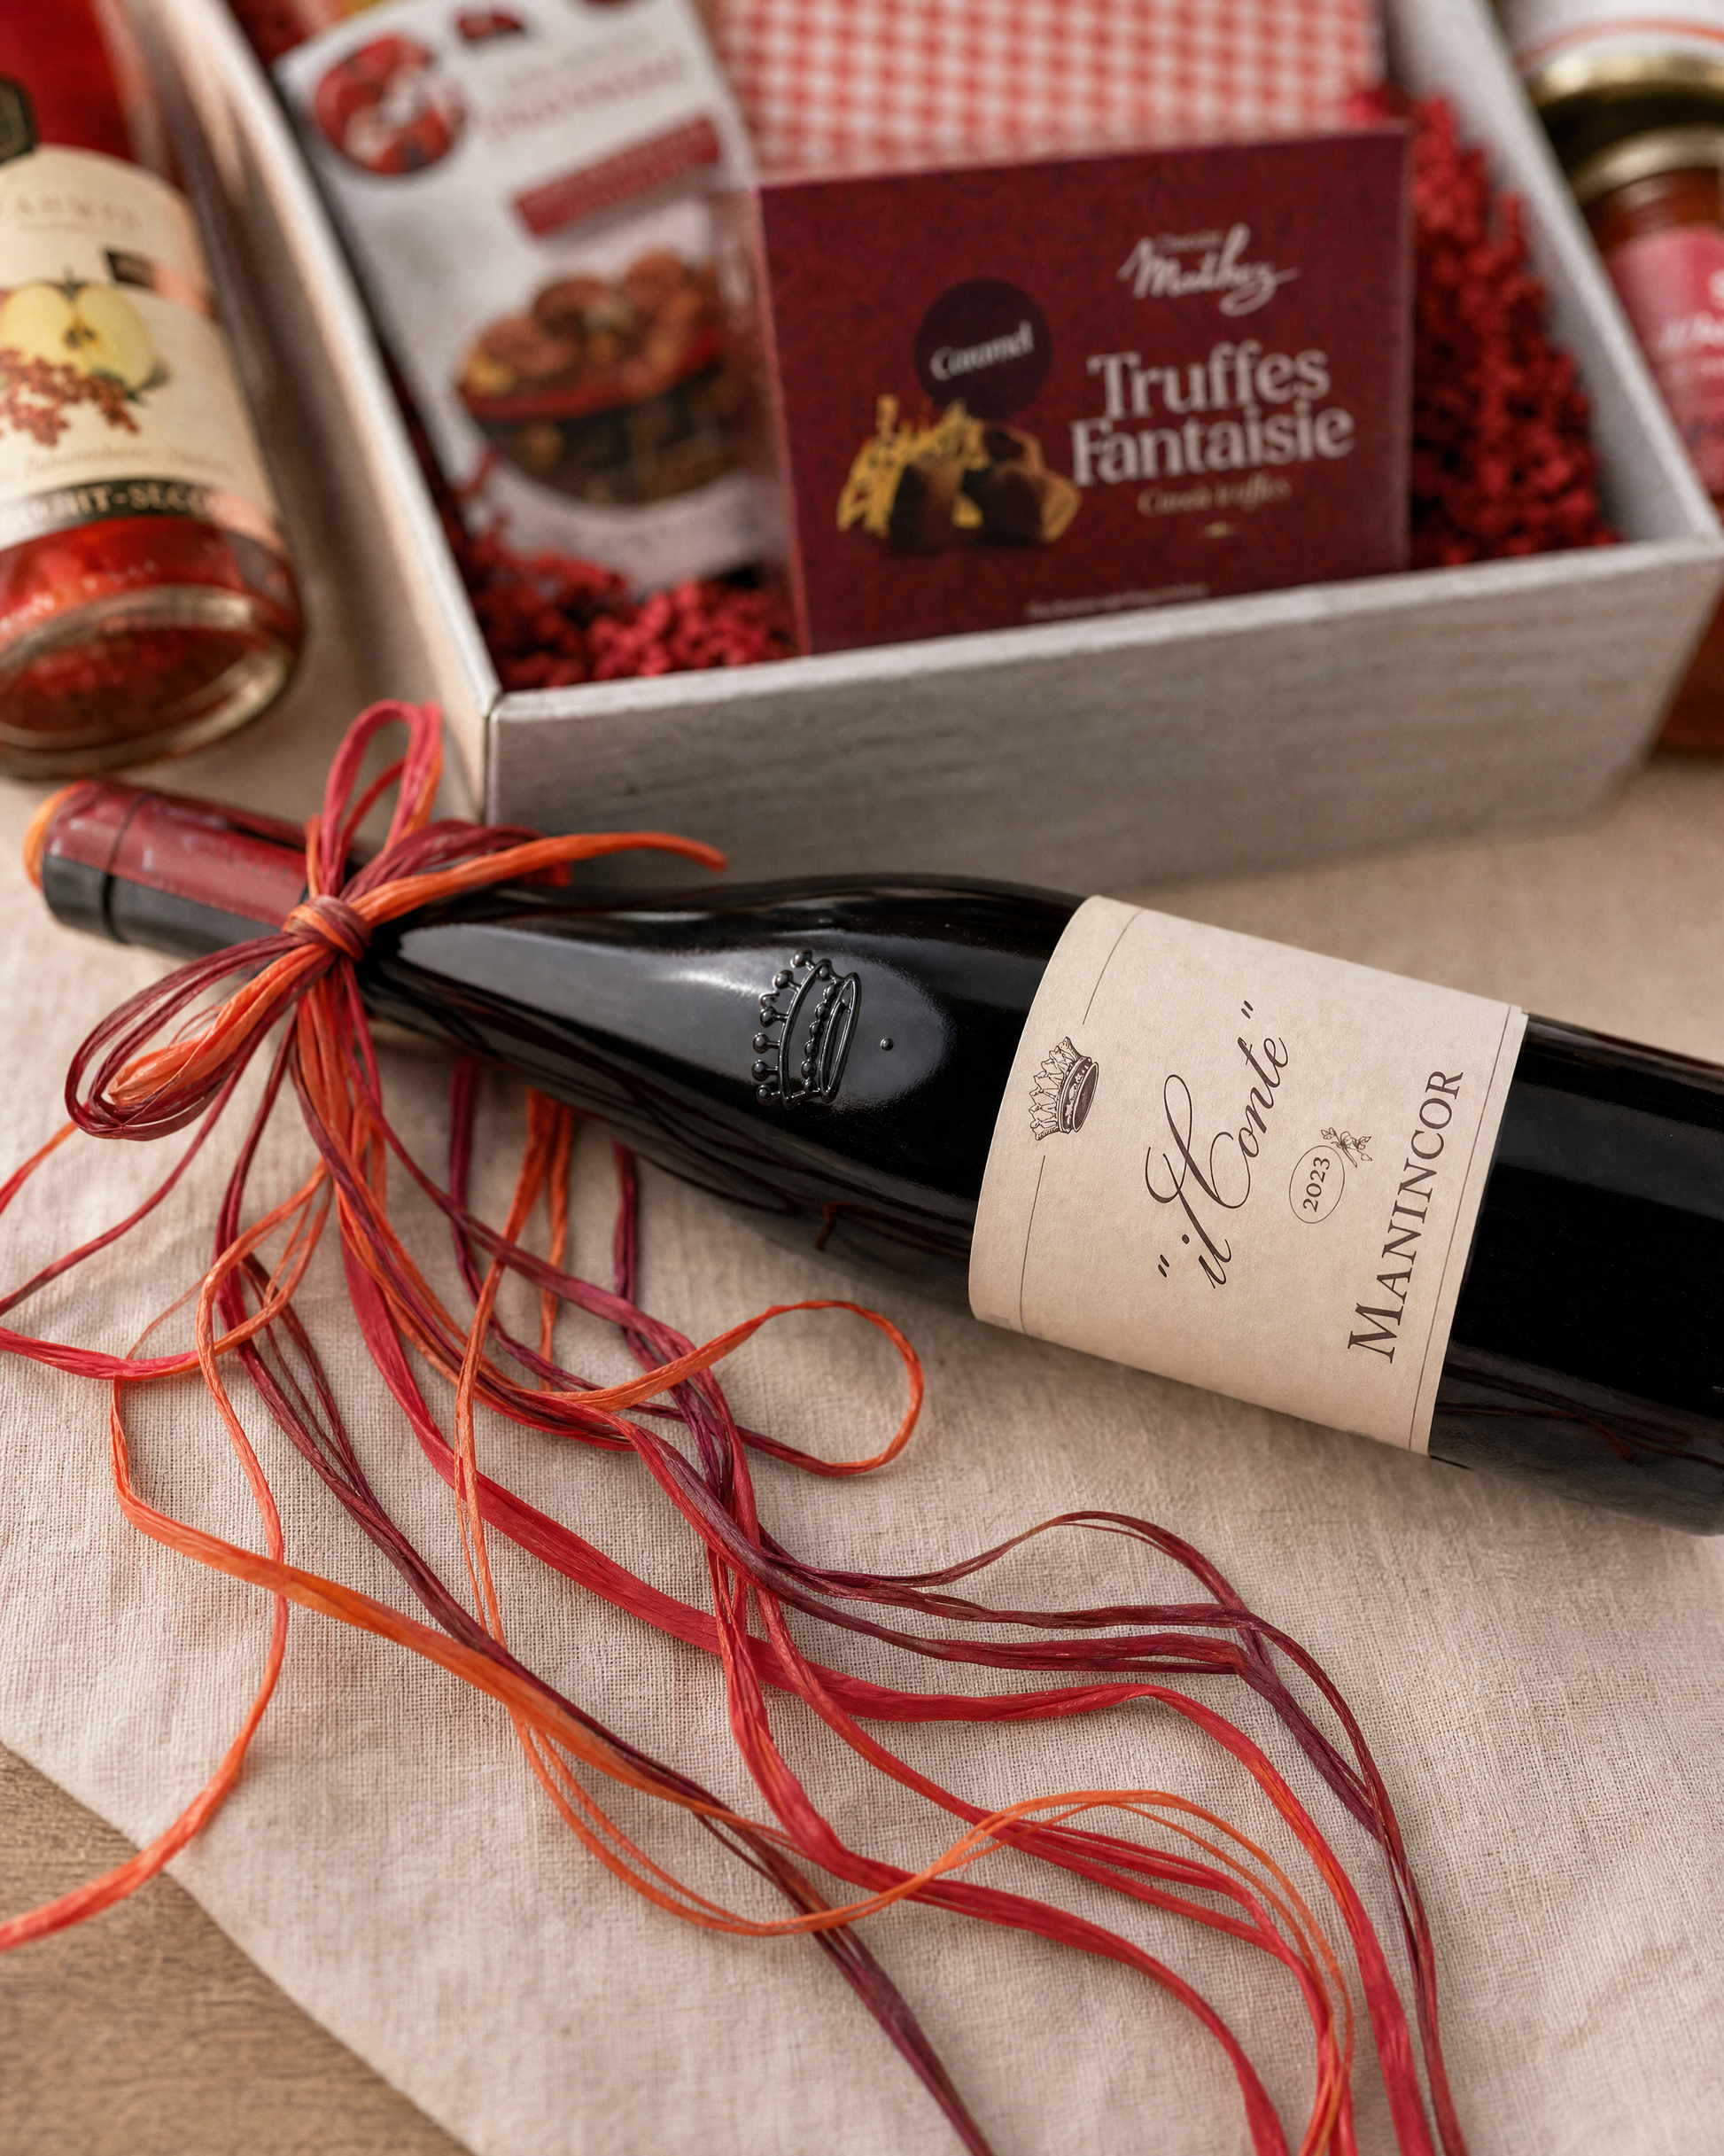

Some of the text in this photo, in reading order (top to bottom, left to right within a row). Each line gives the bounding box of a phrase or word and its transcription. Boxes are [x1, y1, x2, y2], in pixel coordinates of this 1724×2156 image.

[930, 319, 1034, 381] Caramel
[1086, 339, 1331, 419] Truffes
[1069, 400, 1355, 486] Fantaisie
[1302, 1156, 1332, 1212] 2023
[1347, 1070, 1464, 1365] MANINCOR
